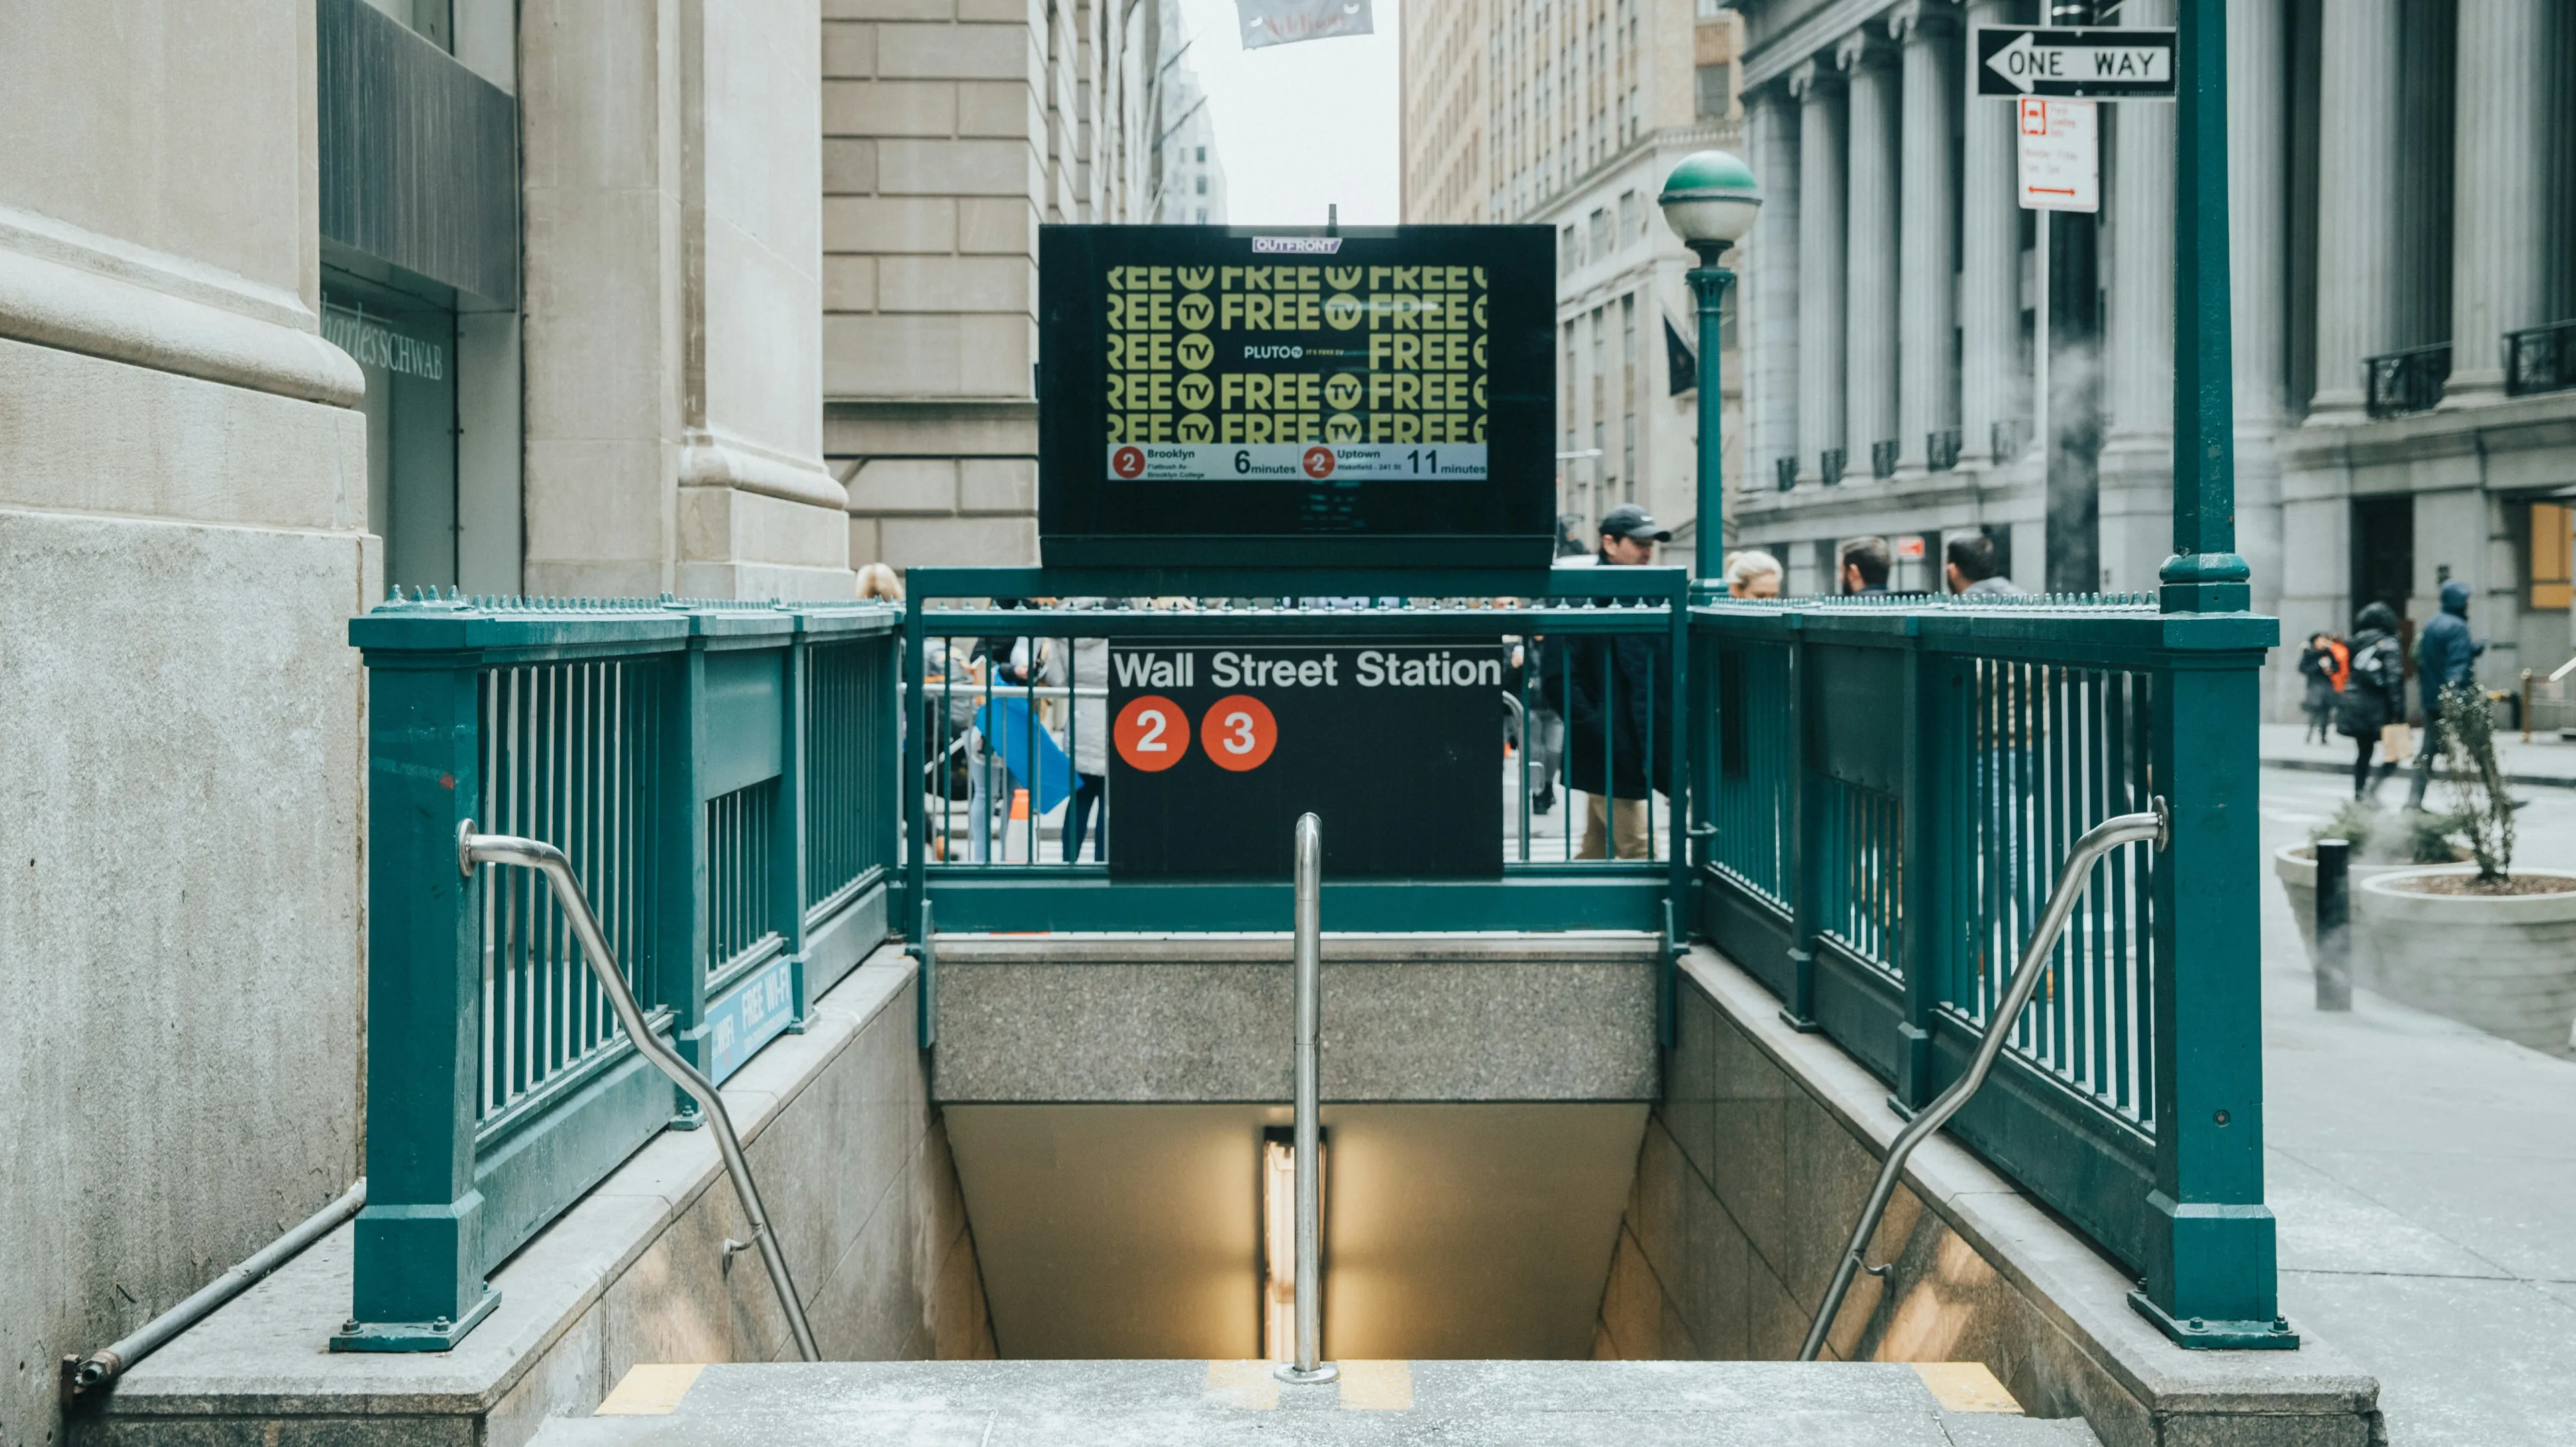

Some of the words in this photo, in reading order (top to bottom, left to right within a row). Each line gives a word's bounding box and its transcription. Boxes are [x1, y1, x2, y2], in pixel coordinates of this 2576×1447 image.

[2008, 51, 2063, 76] ONE
[2094, 52, 2154, 77] WAY
[1256, 239, 1334, 252] OUTFRONT
[1221, 266, 1320, 290] FREE
[1369, 266, 1468, 290] FREE
[1108, 294, 1173, 330] REE
[1221, 294, 1320, 330] FREE
[1369, 294, 1468, 330] FREE
[321, 291, 376, 366] harles
[378, 329, 443, 380] SCHWAB
[1108, 333, 1173, 370] REE
[1244, 345, 1291, 359] PLUTO
[1369, 333, 1468, 370] FREE
[1108, 374, 1173, 410] REE
[1221, 374, 1320, 410] FREE
[1369, 374, 1468, 410] FREE
[1108, 413, 1173, 444] REE
[1221, 413, 1320, 444] FREE
[1369, 413, 1468, 444] FREE
[1122, 453, 1136, 472] 2
[1148, 449, 1195, 459] Brooklyn
[1234, 450, 1251, 474] 6
[1251, 464, 1297, 474] minutes
[1312, 453, 1326, 472] 2
[1337, 450, 1381, 460] Uptown
[1407, 449, 1437, 474] 11
[1441, 464, 1487, 474] minutes
[1114, 652, 1193, 687] Wall
[1211, 651, 1338, 688] Street
[1356, 651, 1501, 687] Station
[1136, 709, 1167, 751] 2
[1223, 712, 1256, 755] 3
[742, 981, 765, 1033] FREE
[765, 964, 790, 1014] WI-FI
